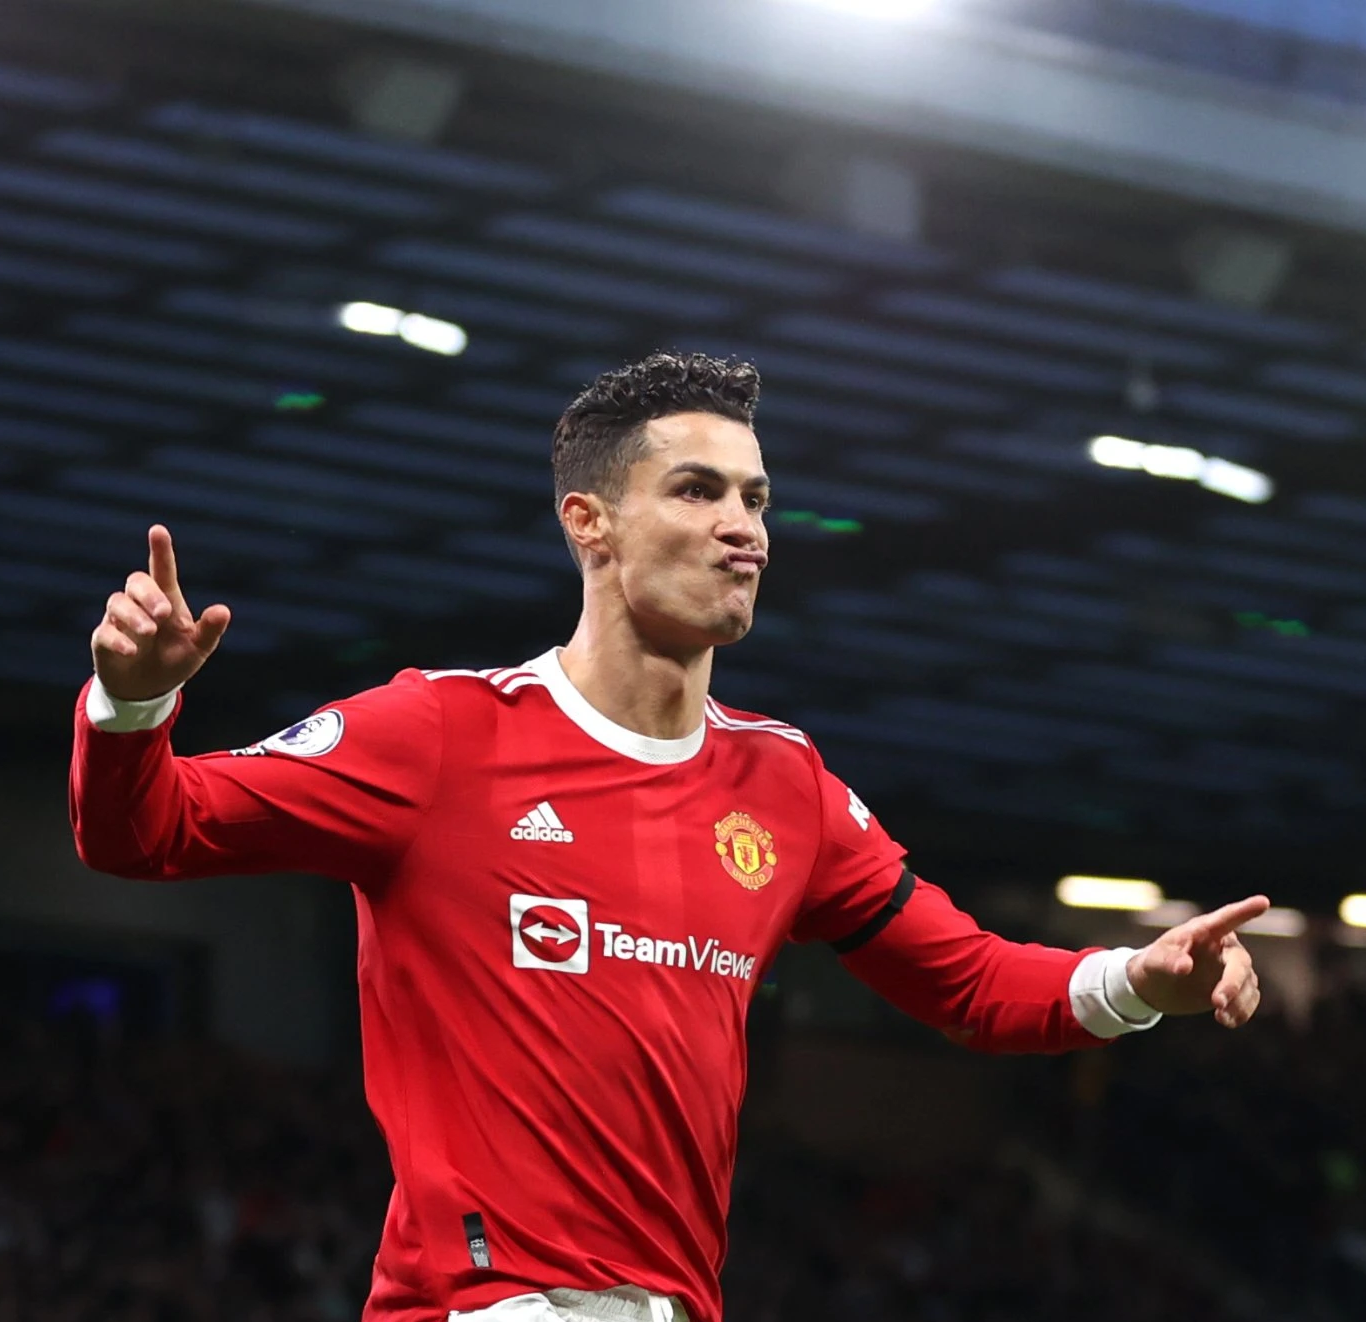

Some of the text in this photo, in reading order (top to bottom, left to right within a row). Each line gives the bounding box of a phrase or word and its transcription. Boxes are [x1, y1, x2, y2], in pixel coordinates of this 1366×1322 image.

[510, 825, 574, 843] adidas
[718, 816, 768, 846] MANCHESTER
[732, 867, 766, 885] UNITED
[594, 922, 756, 981] TeamViewe
